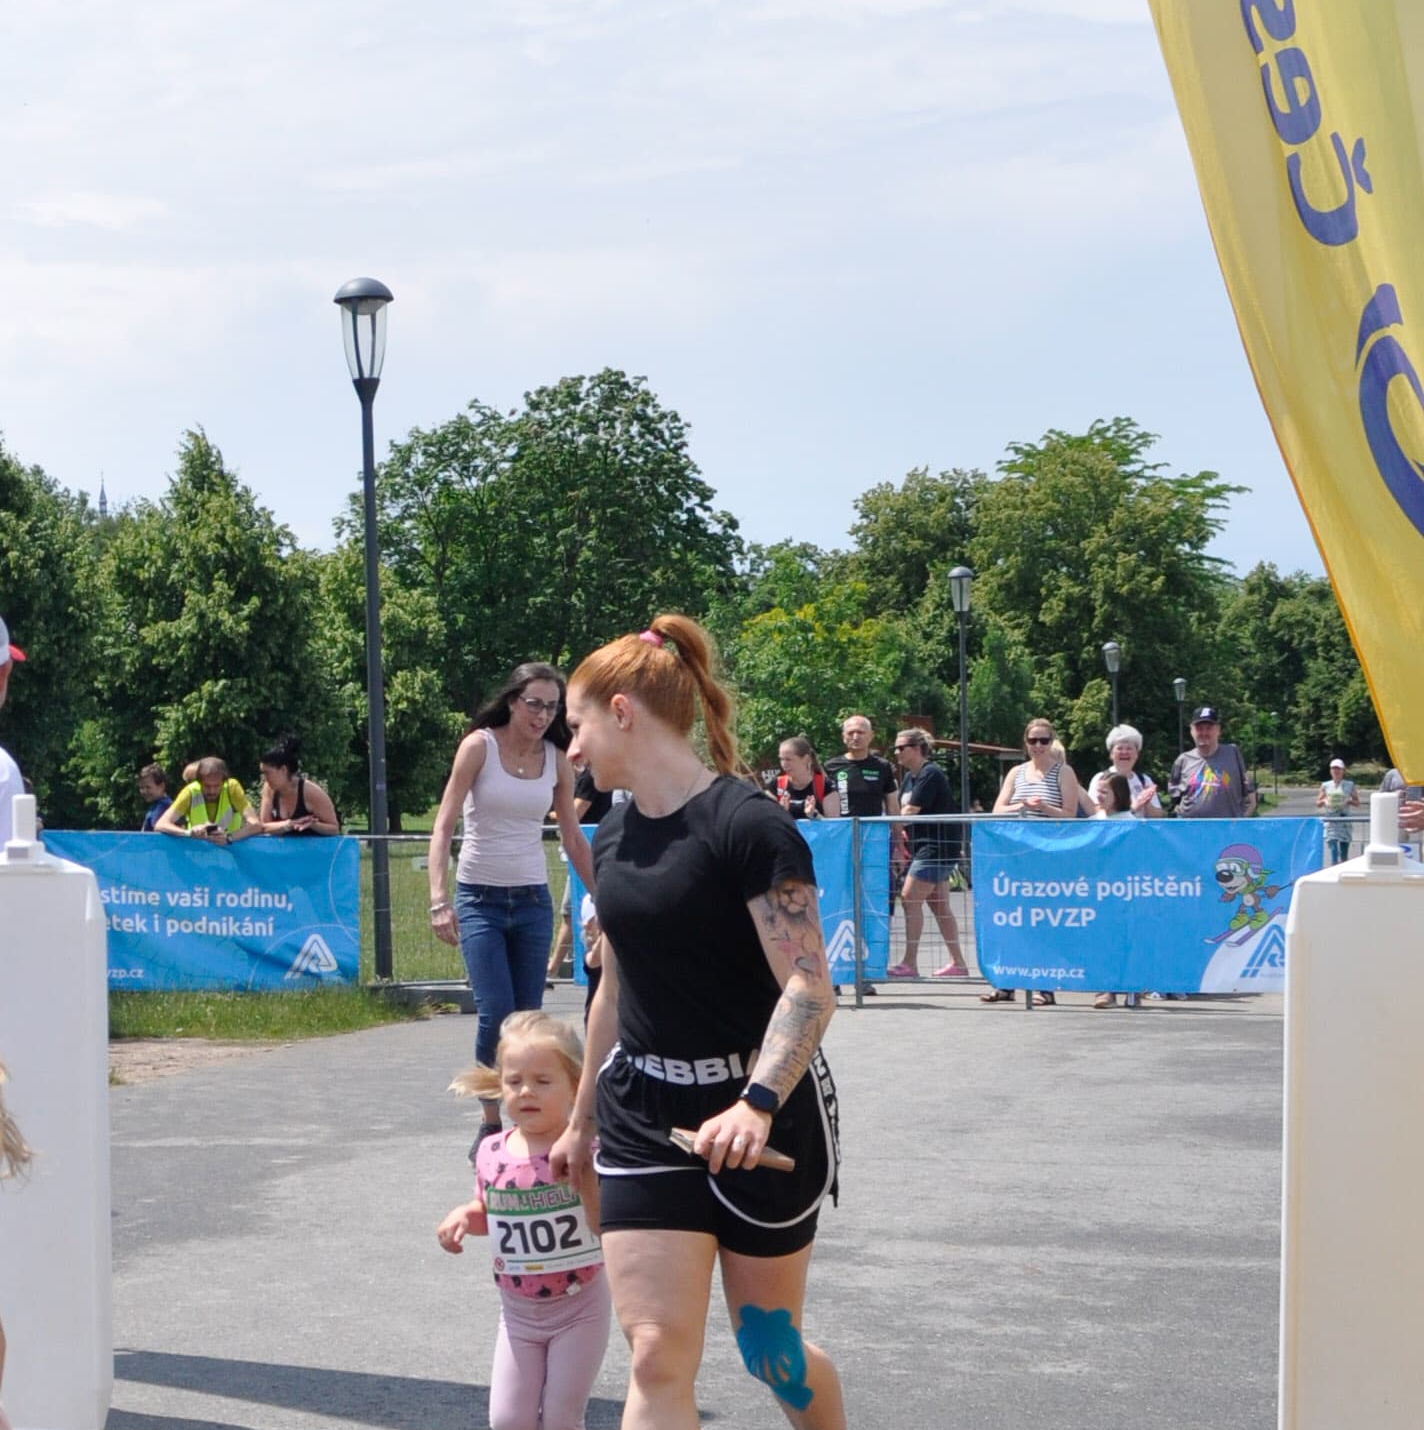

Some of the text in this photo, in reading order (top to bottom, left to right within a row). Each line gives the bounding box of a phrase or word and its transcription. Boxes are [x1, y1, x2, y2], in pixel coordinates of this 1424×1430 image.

[165, 886, 210, 908] vaši
[215, 887, 294, 912] rodinu,
[991, 871, 1202, 902] Úrazové pojištění
[153, 913, 161, 933] i
[165, 915, 276, 938] podnikání
[992, 907, 1097, 927] od PVZP
[992, 965, 1086, 980] www.pvzp.cz
[496, 1214, 583, 1255] 2102
